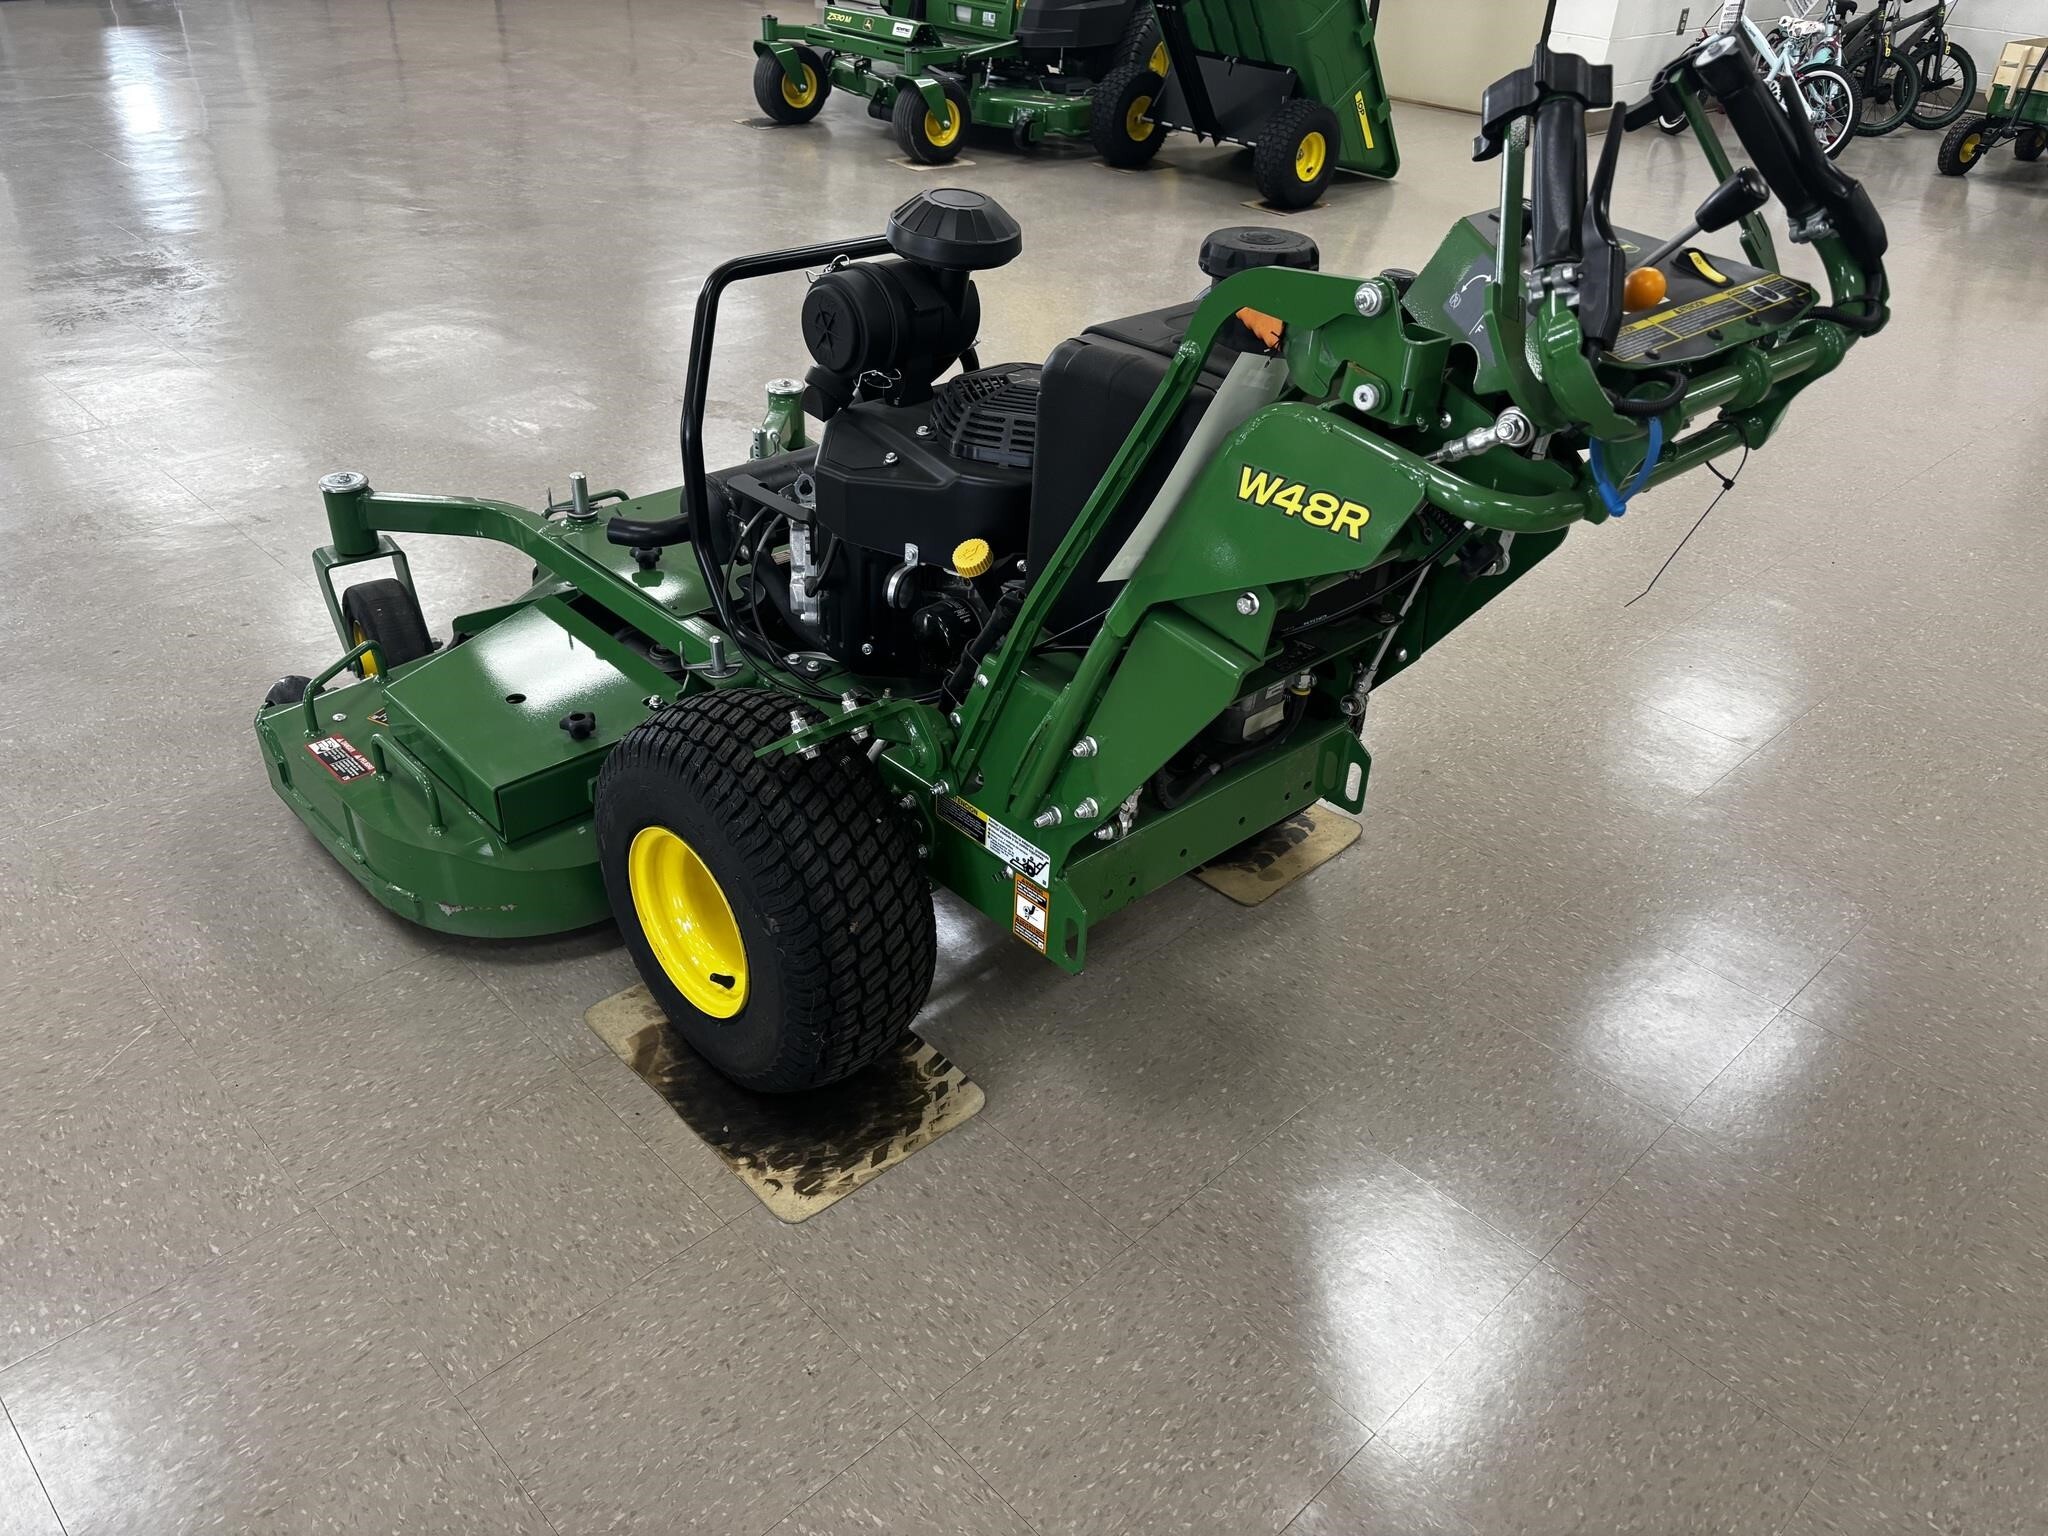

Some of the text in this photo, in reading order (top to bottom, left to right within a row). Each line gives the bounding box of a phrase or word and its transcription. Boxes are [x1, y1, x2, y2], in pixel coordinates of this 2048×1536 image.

[827, 12, 845, 22] Z530
[1474, 324, 1484, 334] F
[1237, 464, 1371, 542] W48R
